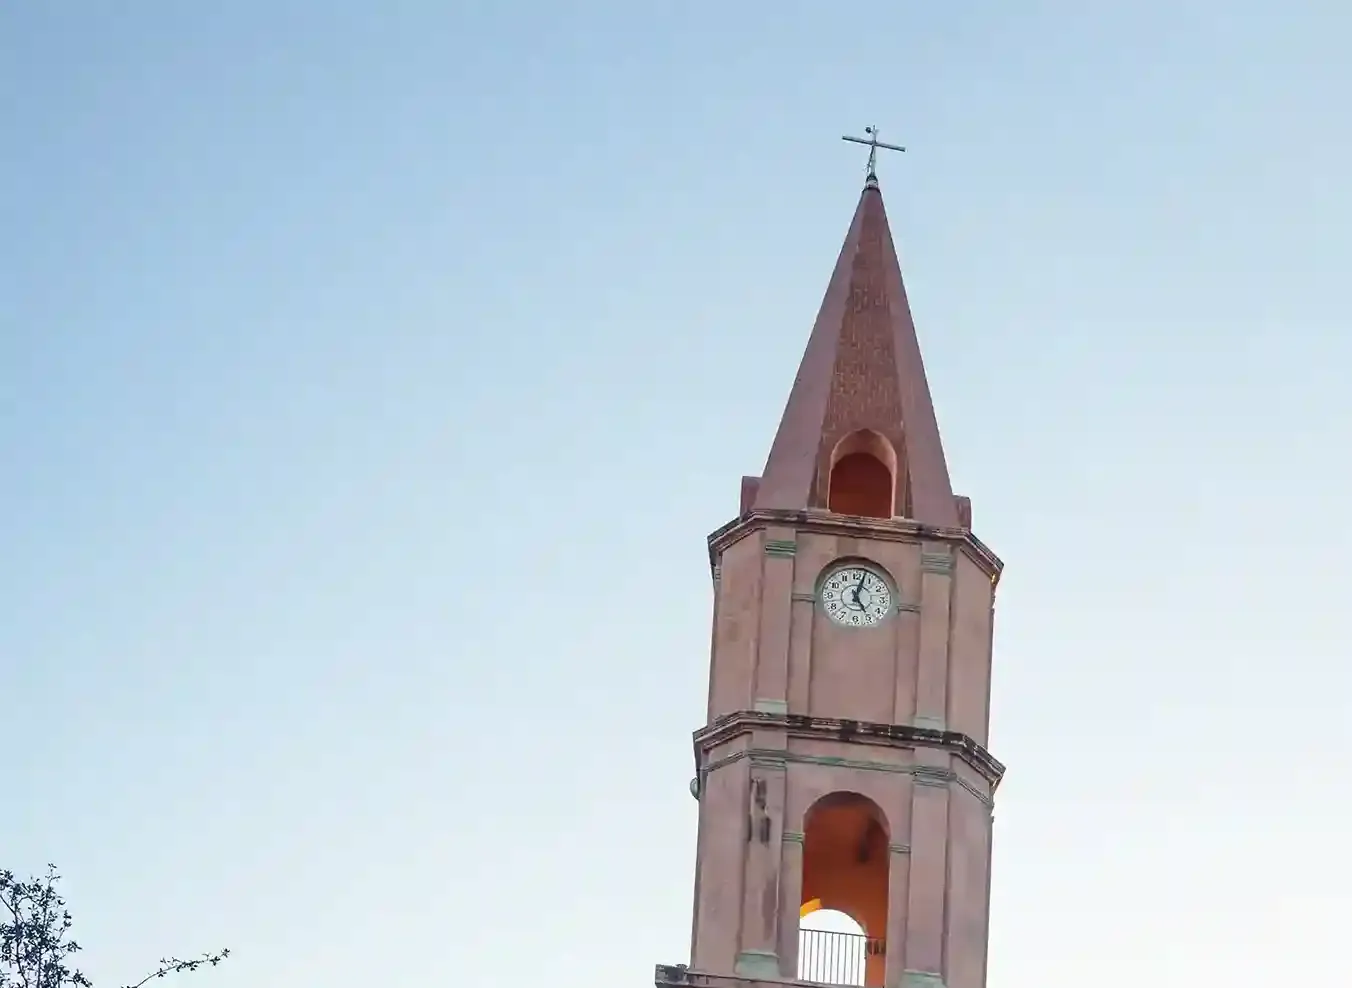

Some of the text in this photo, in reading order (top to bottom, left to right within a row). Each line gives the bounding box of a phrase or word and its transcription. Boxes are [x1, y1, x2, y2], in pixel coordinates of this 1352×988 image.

[879, 596, 886, 604] 3
[839, 611, 846, 620] 7
[865, 613, 871, 621] 5
